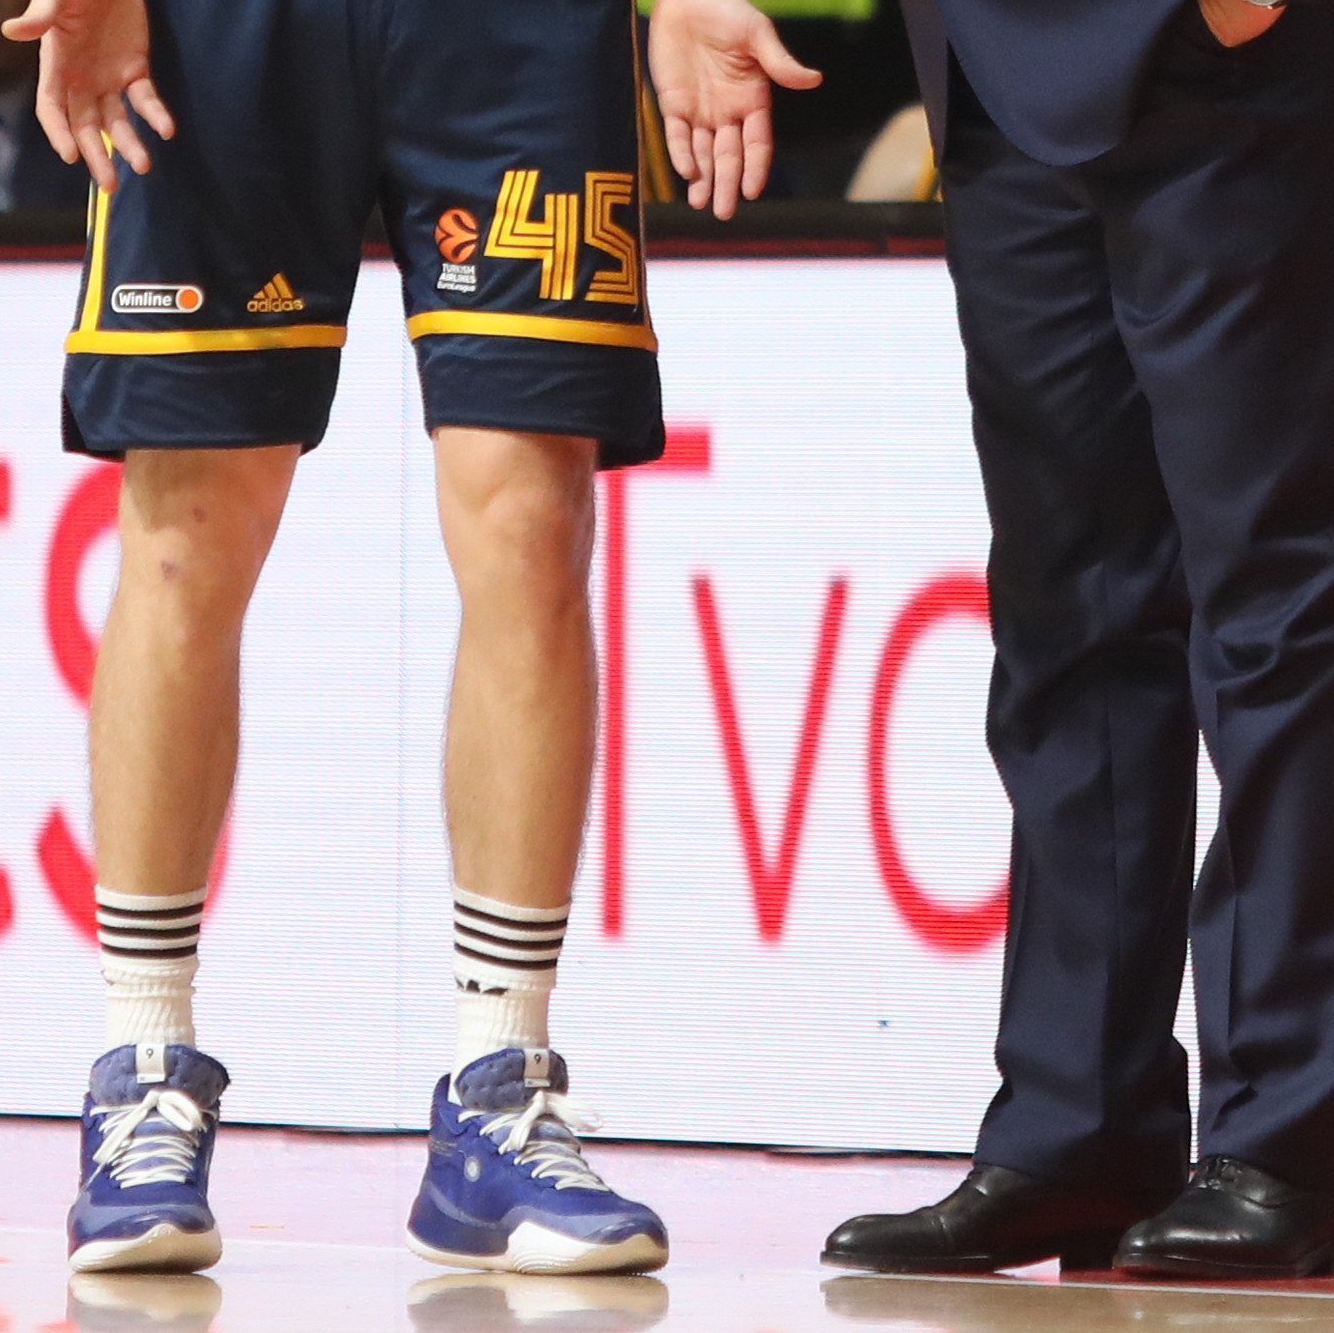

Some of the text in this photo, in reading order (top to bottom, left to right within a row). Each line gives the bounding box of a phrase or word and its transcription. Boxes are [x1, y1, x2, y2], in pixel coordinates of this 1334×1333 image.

[484, 169, 639, 305] 45
[118, 291, 172, 307] Winline
[247, 298, 304, 312] adidas
[595, 423, 1013, 952] Tvo
